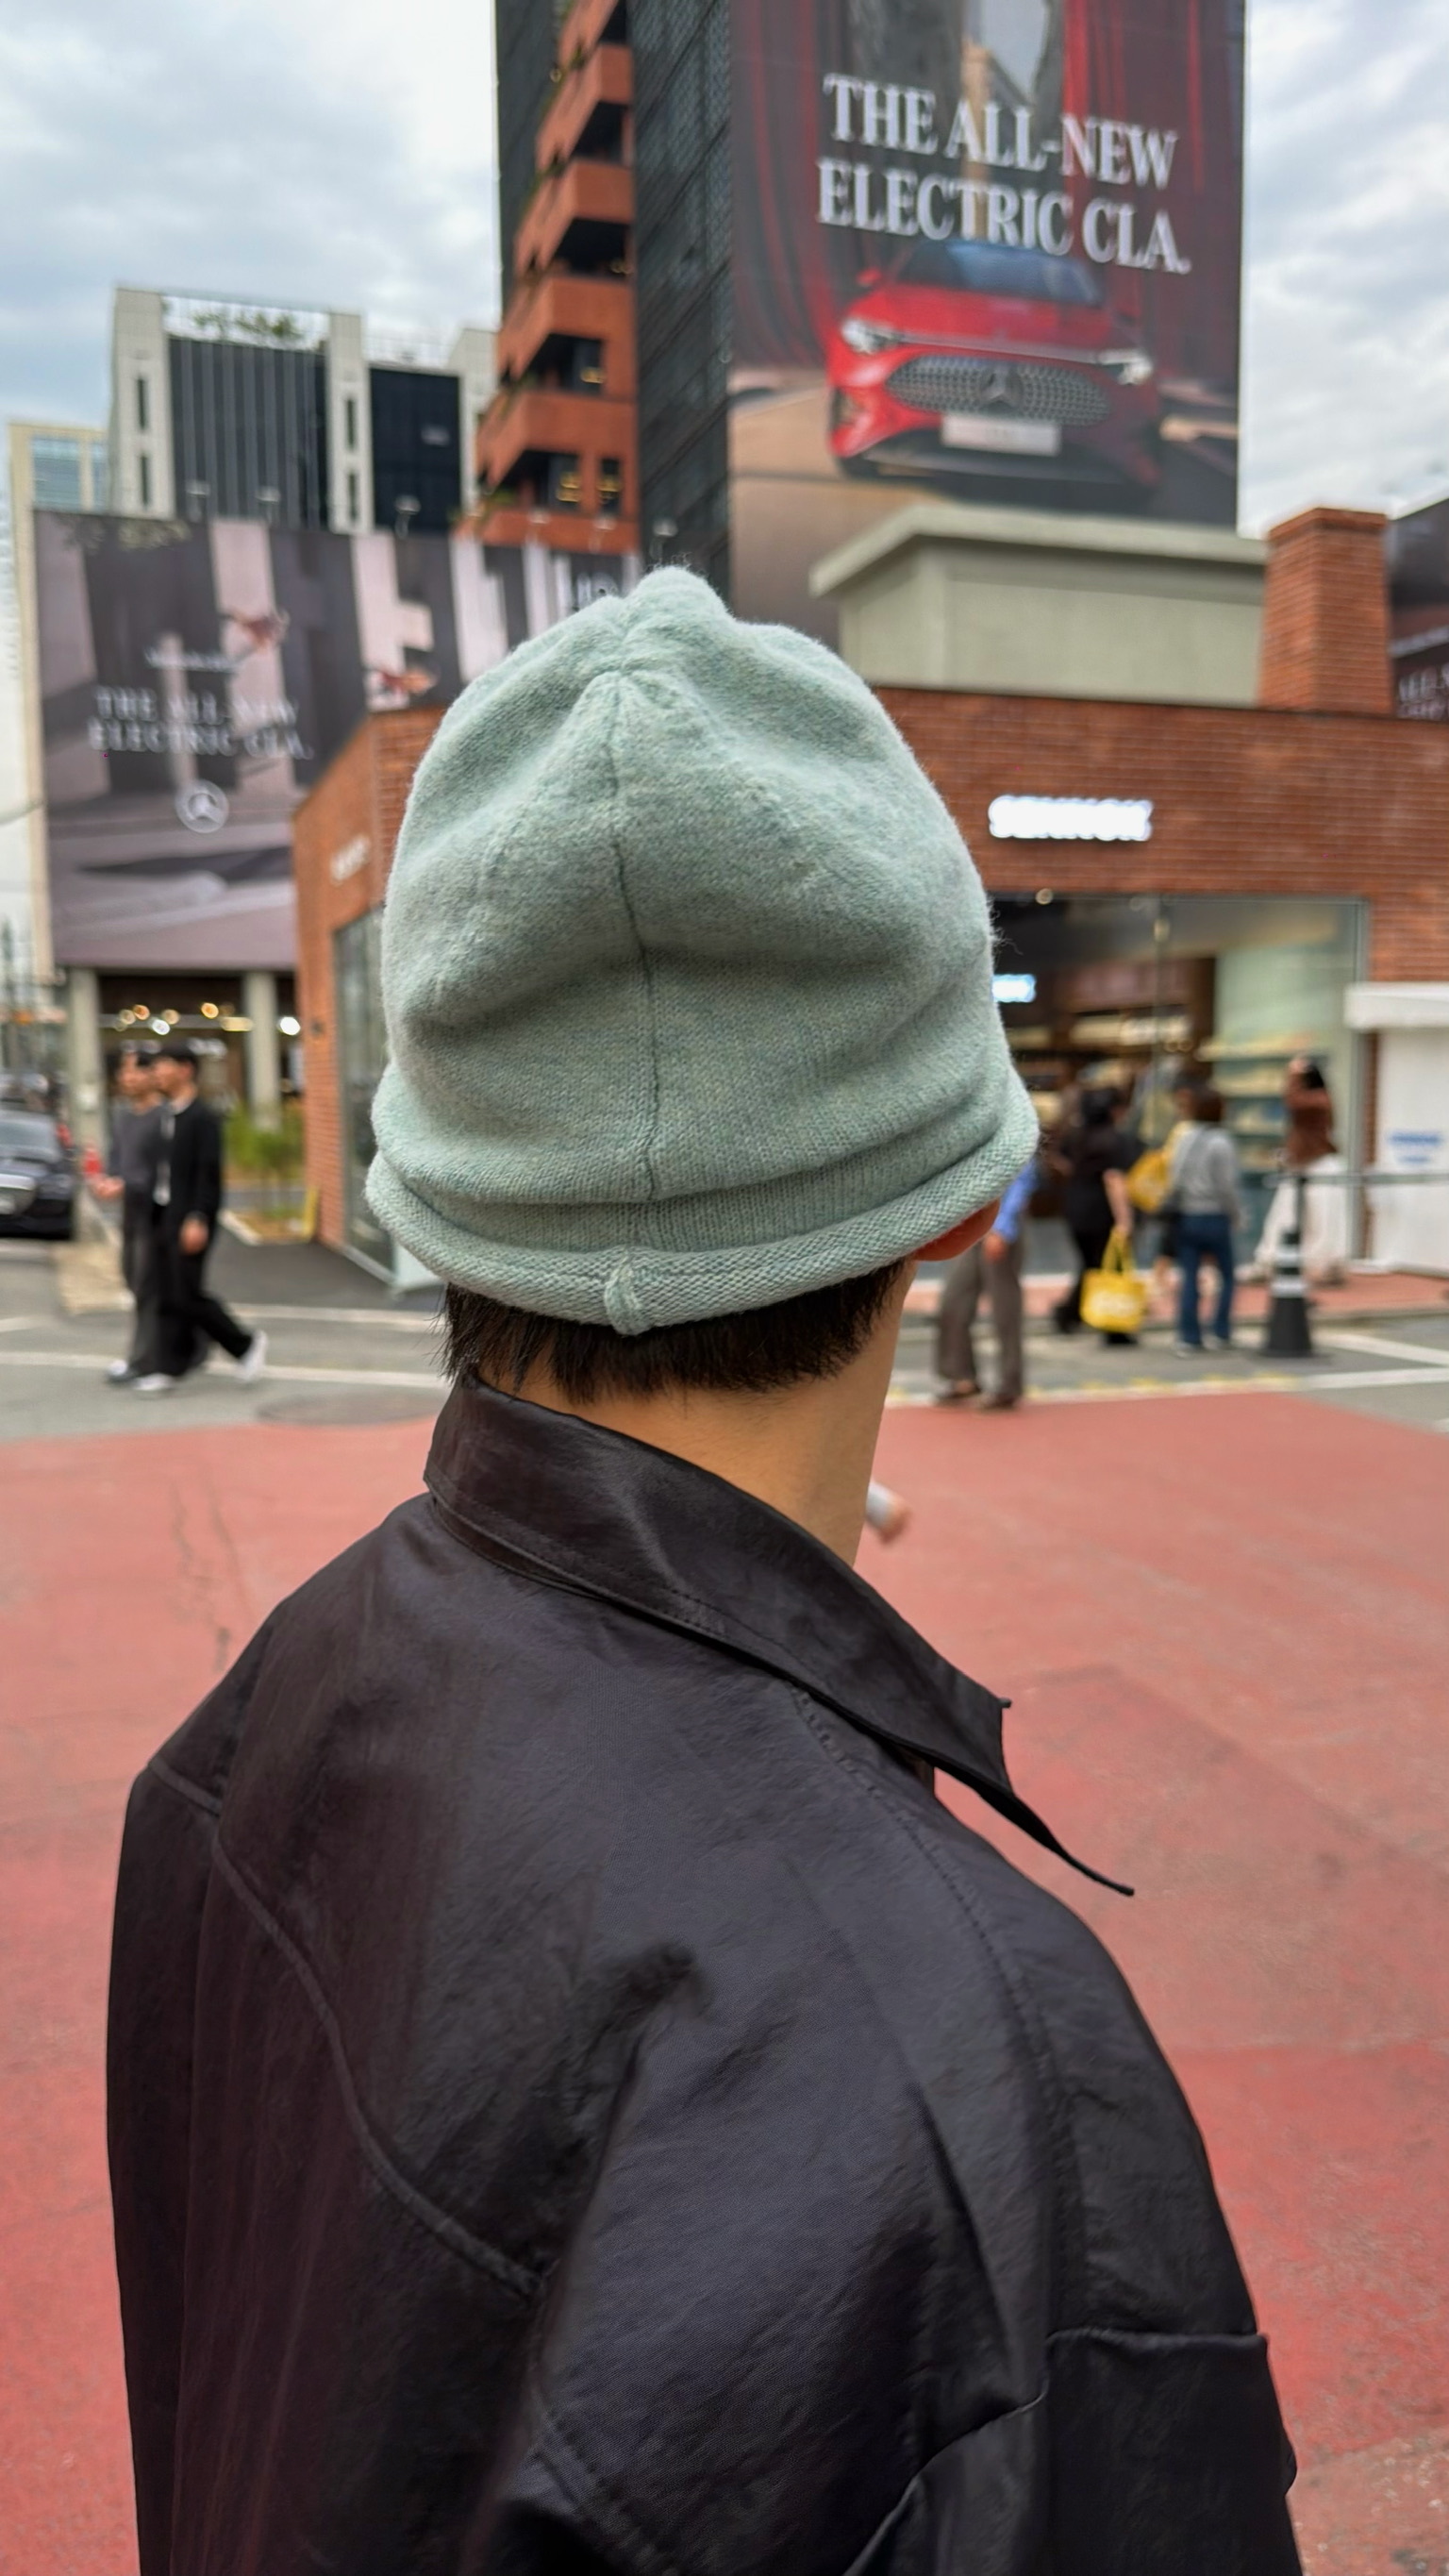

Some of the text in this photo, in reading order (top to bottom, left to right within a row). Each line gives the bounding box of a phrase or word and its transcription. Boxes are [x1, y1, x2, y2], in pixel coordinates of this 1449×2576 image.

[822, 73, 1179, 190] THE ALL-NEW
[816, 156, 1192, 276] ELECTRIC CLA.
